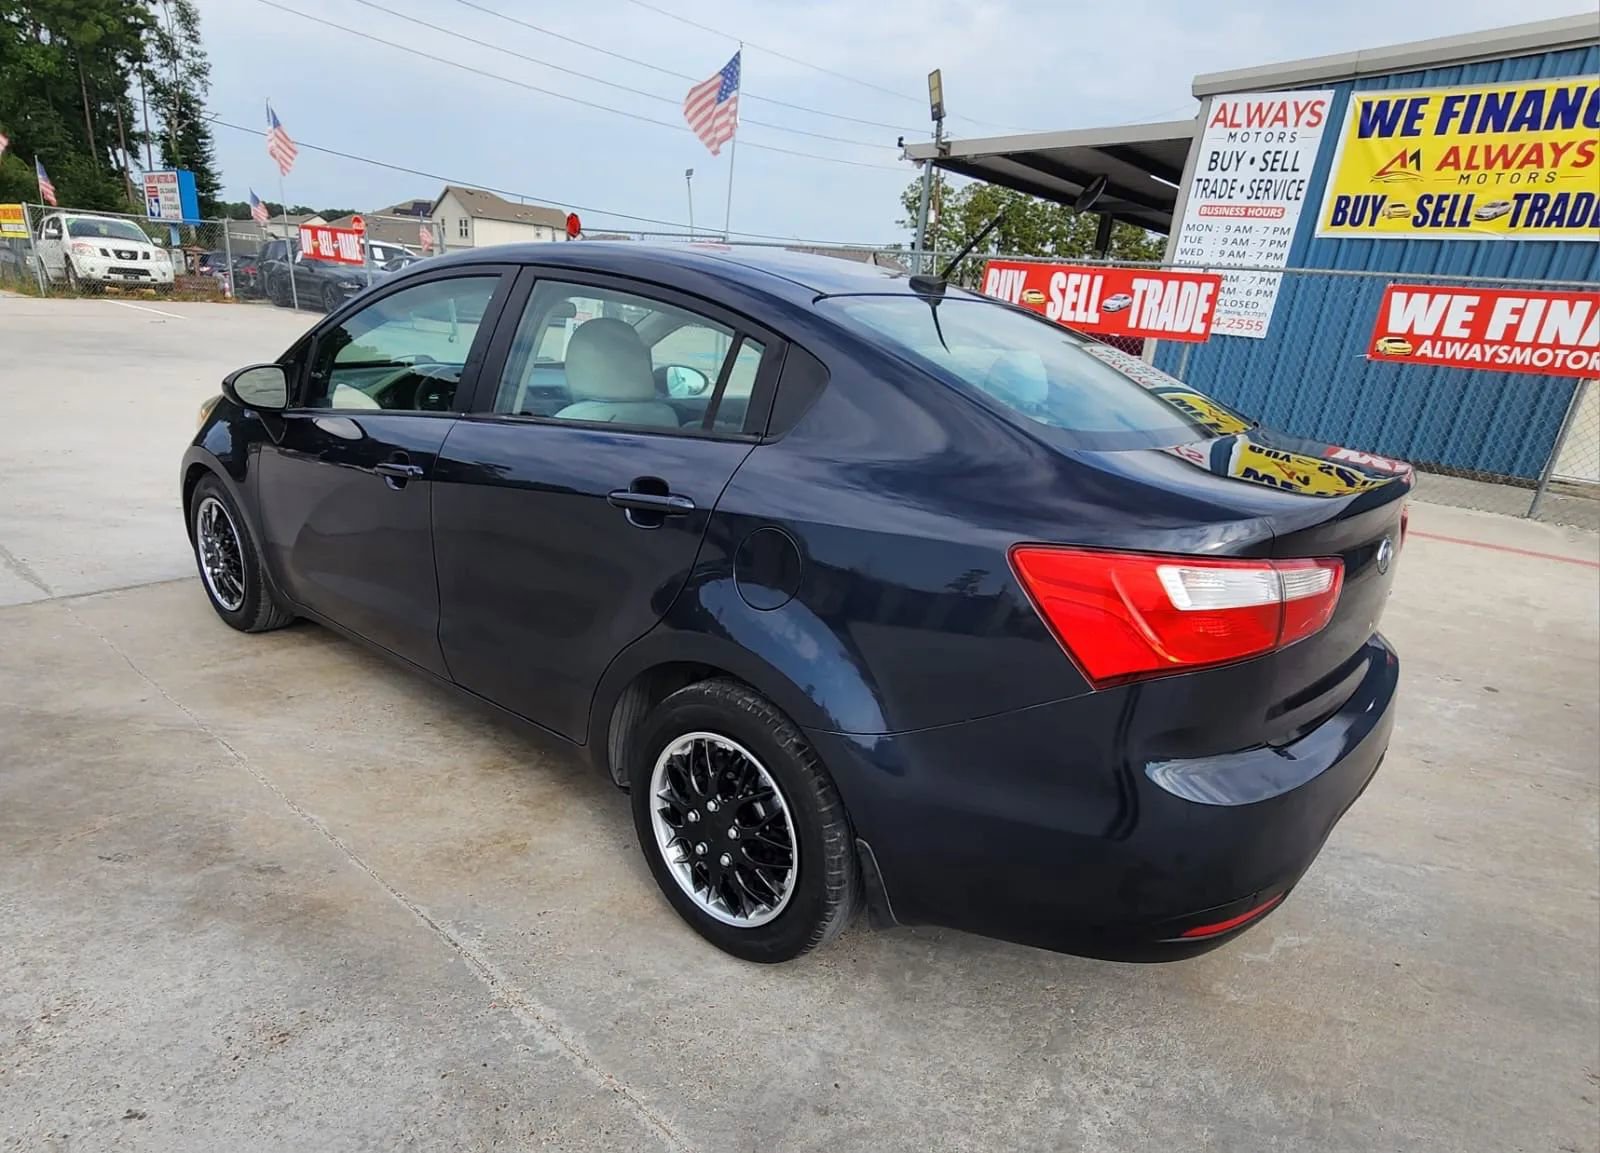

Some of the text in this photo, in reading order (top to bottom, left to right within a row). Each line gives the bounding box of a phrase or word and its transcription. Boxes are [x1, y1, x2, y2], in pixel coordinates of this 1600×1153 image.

[1210, 100, 1325, 128] ALWAYS
[1358, 97, 1430, 139] WE
[1227, 131, 1298, 143] MOTORS
[1208, 150, 1300, 172] BUY SELL
[1435, 139, 1598, 171] ALWAYS
[1458, 171, 1557, 185] MOTORS
[1194, 178, 1305, 201] TRADE SERVICE
[1200, 206, 1284, 218] BUSINESS HOURS
[1330, 195, 1387, 227] BUY
[1412, 194, 1475, 227] SELL
[1185, 223, 1214, 233] MON
[1224, 225, 1232, 233] 9
[1234, 225, 1252, 234] AM
[1272, 227, 1291, 236] PM
[1184, 235, 1204, 244] TUE
[1221, 237, 1228, 246] 9
[1230, 238, 1249, 246] AM
[1260, 239, 1266, 247] 7
[1269, 240, 1287, 248] PM
[1180, 248, 1204, 256] WED
[1227, 250, 1246, 259] AM
[1256, 251, 1263, 260] 7
[1265, 252, 1284, 261] PM
[1258, 278, 1277, 287] PM
[1246, 288, 1253, 297] 6
[1255, 290, 1274, 299] PM
[1046, 271, 1104, 324] SELL
[1127, 278, 1215, 334] TRADE
[1216, 298, 1259, 309] CLOSED
[1387, 291, 1480, 339] WE
